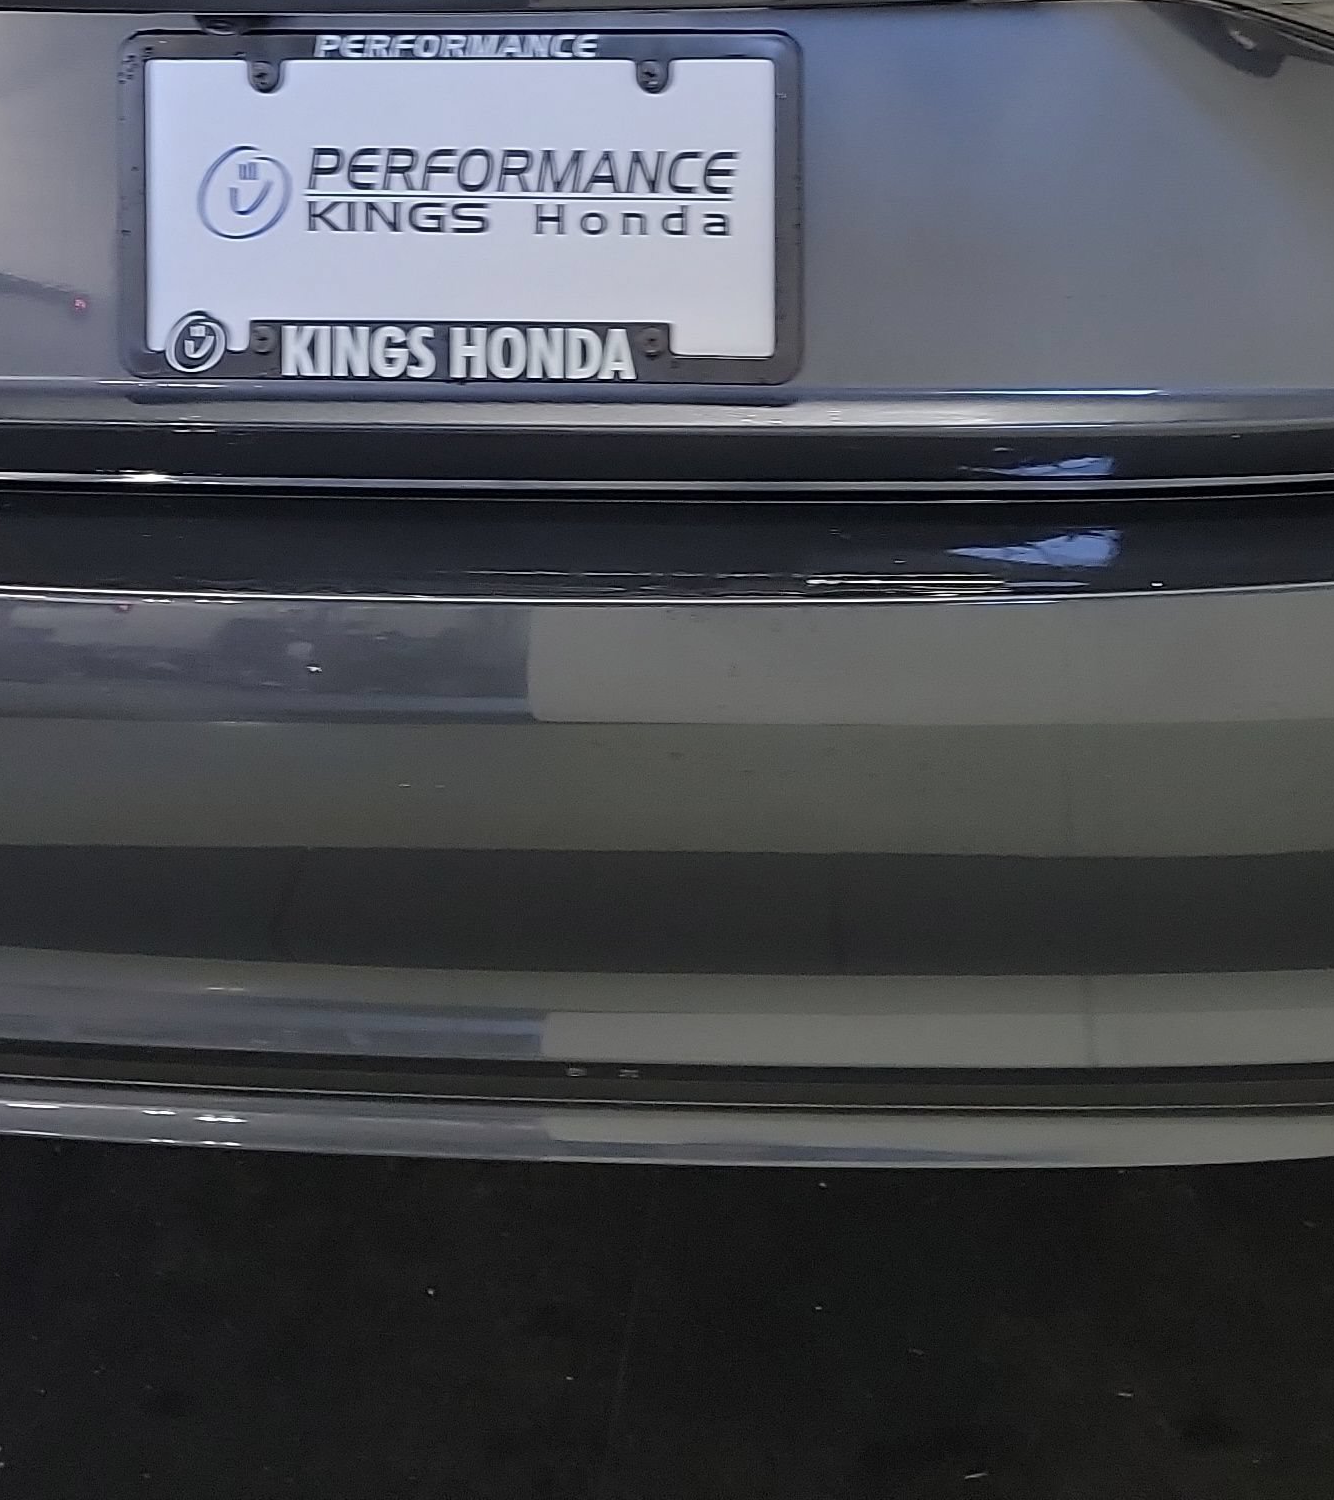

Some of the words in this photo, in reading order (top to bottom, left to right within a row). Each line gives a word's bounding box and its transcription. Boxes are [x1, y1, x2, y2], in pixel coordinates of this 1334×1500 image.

[314, 34, 598, 58] PERFORMANCE
[308, 147, 740, 194] PERFORMANCE
[306, 201, 491, 233] KINGS
[533, 204, 733, 237] Honda
[281, 325, 436, 378] KINGS
[448, 327, 638, 380] HONDA
